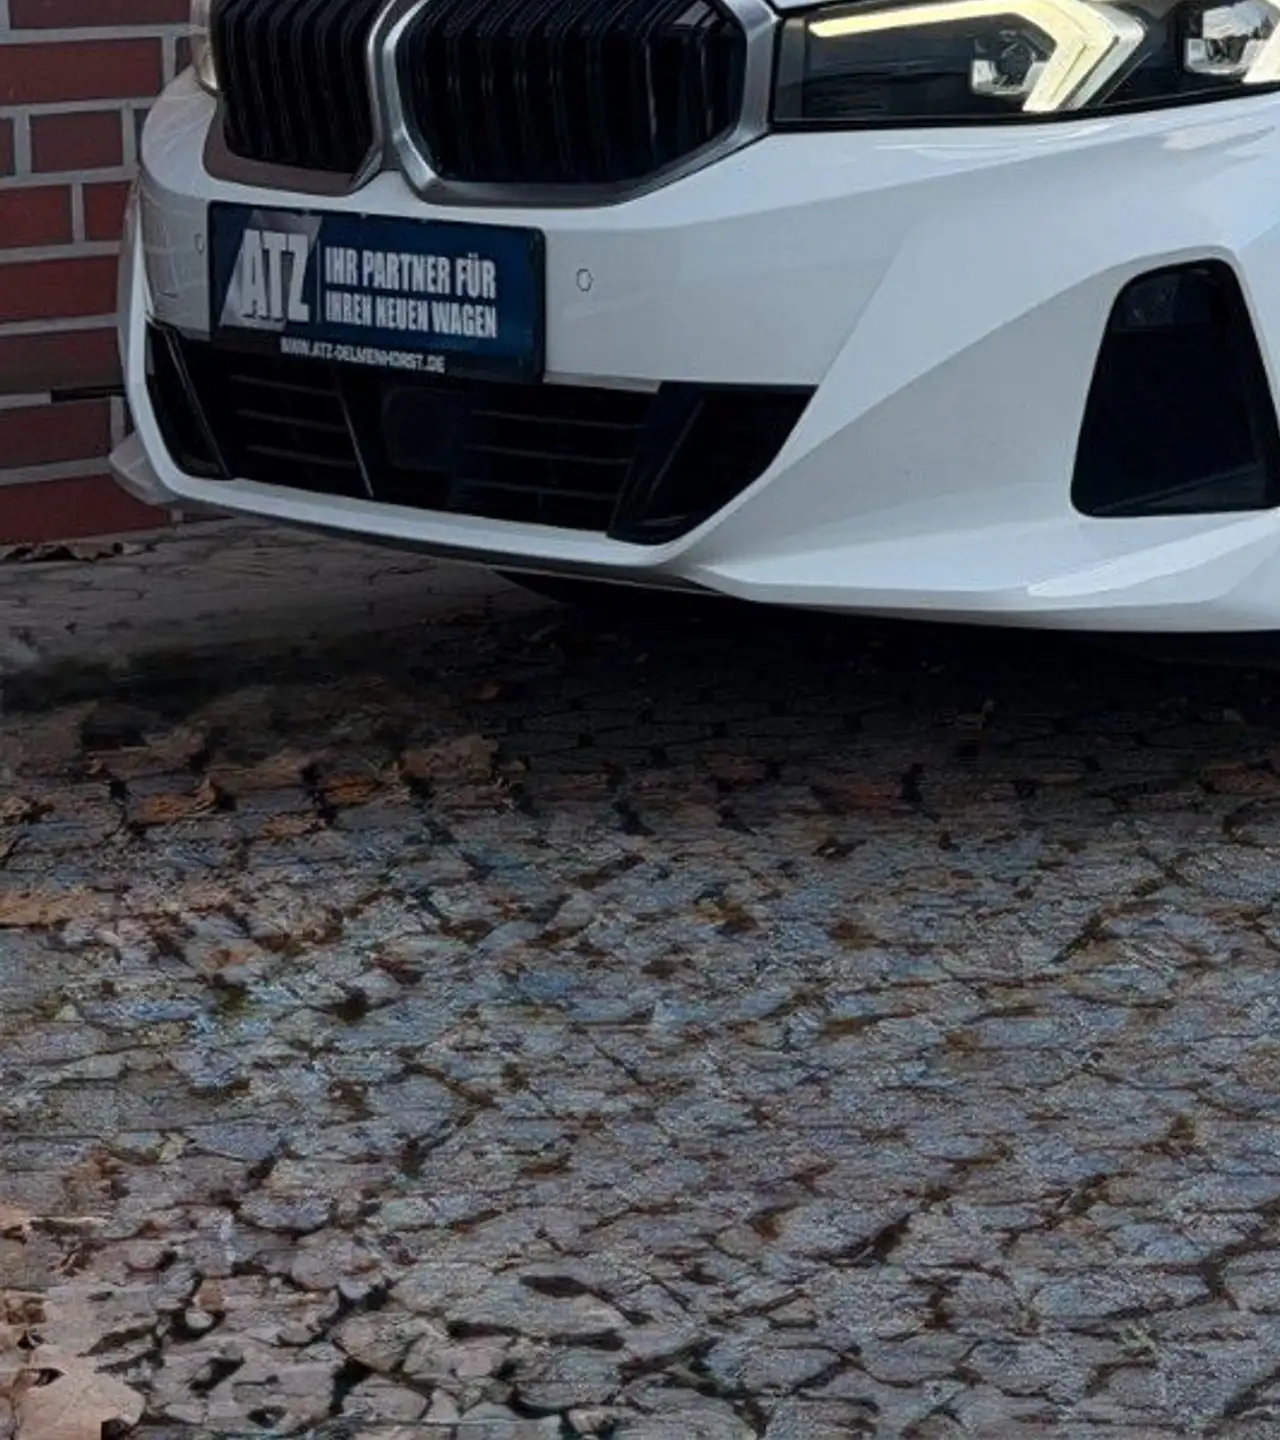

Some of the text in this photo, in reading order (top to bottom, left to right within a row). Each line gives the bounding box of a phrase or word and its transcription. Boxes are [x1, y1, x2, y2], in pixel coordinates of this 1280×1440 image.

[243, 229, 310, 322] ATZ
[325, 246, 498, 301] IHR PARTNER FÜR
[325, 290, 498, 339] IHREN NEUEN WAGEN
